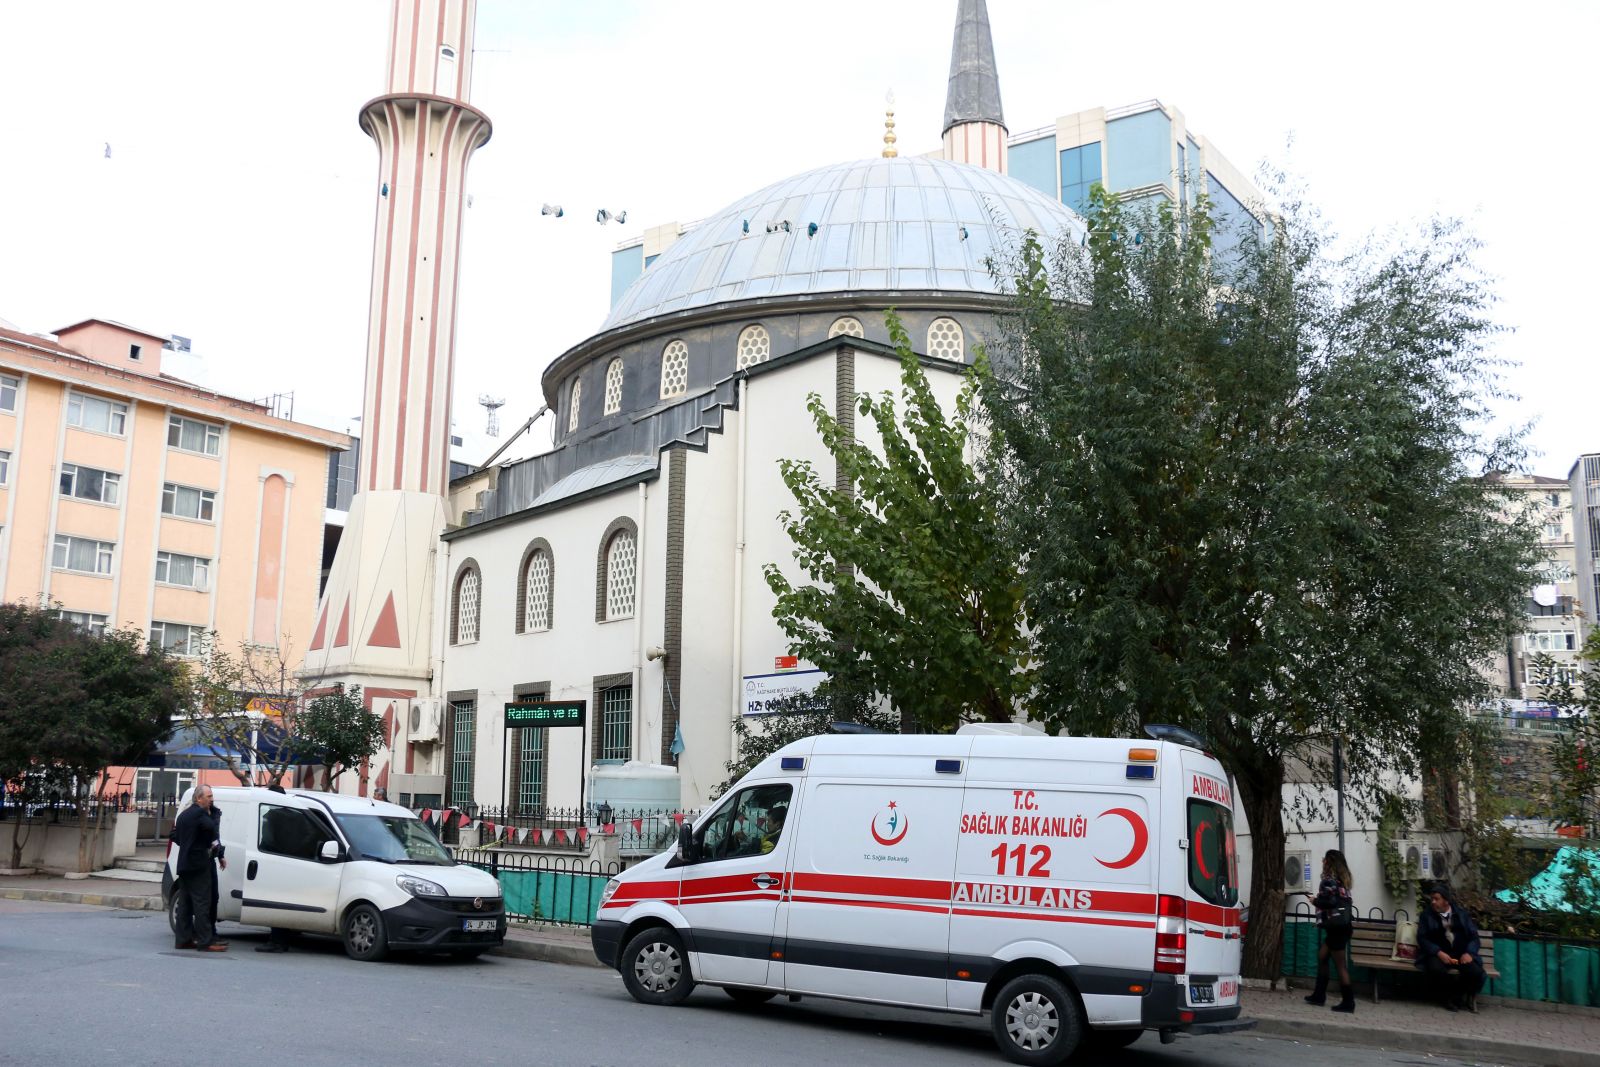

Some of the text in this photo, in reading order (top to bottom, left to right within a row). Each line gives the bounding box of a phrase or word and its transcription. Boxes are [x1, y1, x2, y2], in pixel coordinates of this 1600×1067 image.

[508, 707, 578, 719] Rahmân ve ra
[1013, 790, 1039, 810] T.C.
[960, 811, 1088, 838] SAĞLIK BAKANLIĞI
[991, 842, 1051, 878] 112
[953, 883, 1092, 909] AMBULANS
